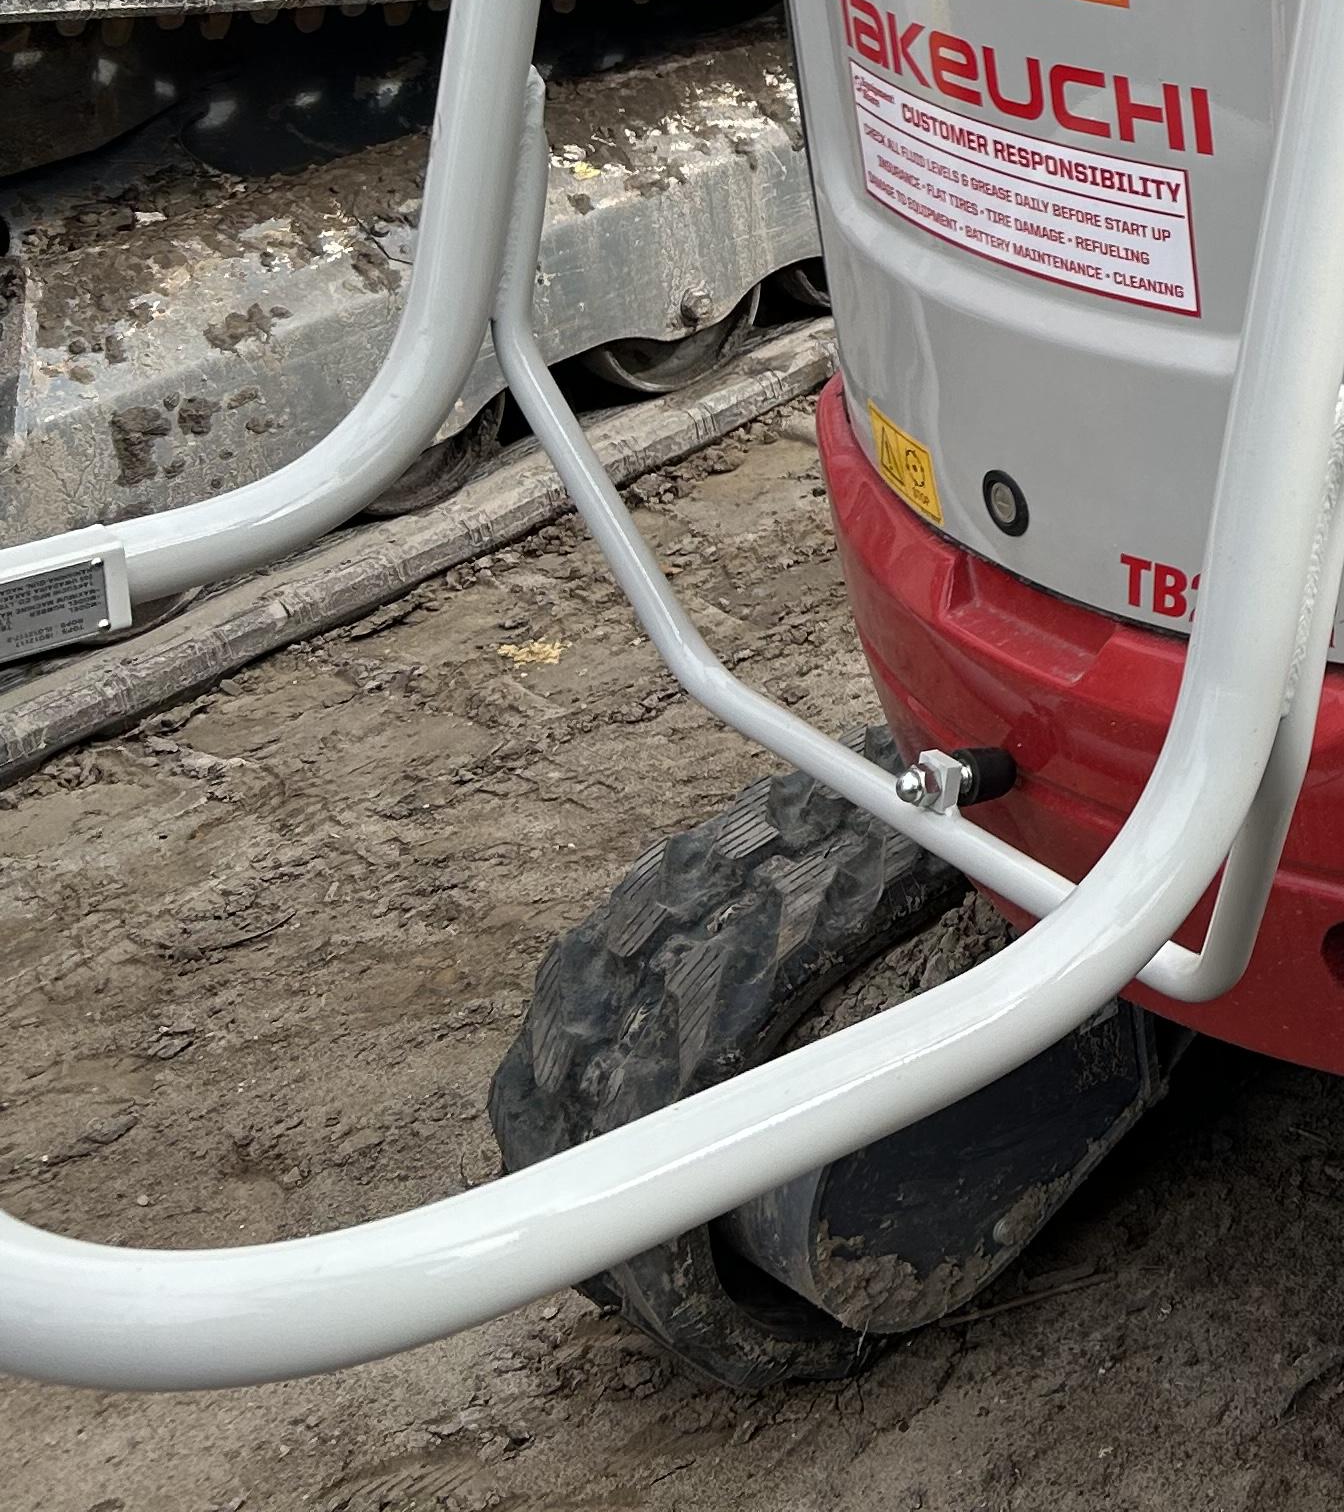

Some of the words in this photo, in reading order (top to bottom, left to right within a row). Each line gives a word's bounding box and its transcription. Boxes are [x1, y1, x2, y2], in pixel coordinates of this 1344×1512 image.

[901, 103, 990, 155] CUSTOMER
[992, 142, 1182, 203] RESPONSIBILITY
[926, 160, 960, 183] LEVELS
[970, 177, 1013, 204] GREASE
[1014, 192, 1050, 214] DAILY
[1051, 203, 1103, 228] BEFORE
[1104, 217, 1149, 238] START
[1151, 226, 1171, 242] UP
[926, 183, 947, 203] FLAT
[949, 192, 979, 216] TIRES
[985, 207, 1013, 228] TIRE
[1014, 217, 1066, 245] DAMAGE
[1075, 235, 1151, 265] REFUELING
[964, 224, 1011, 253] BATTERY
[1012, 242, 1103, 280] MAINTENANCE
[1113, 271, 1185, 299] CLEANING
[1120, 552, 1201, 623] TB
